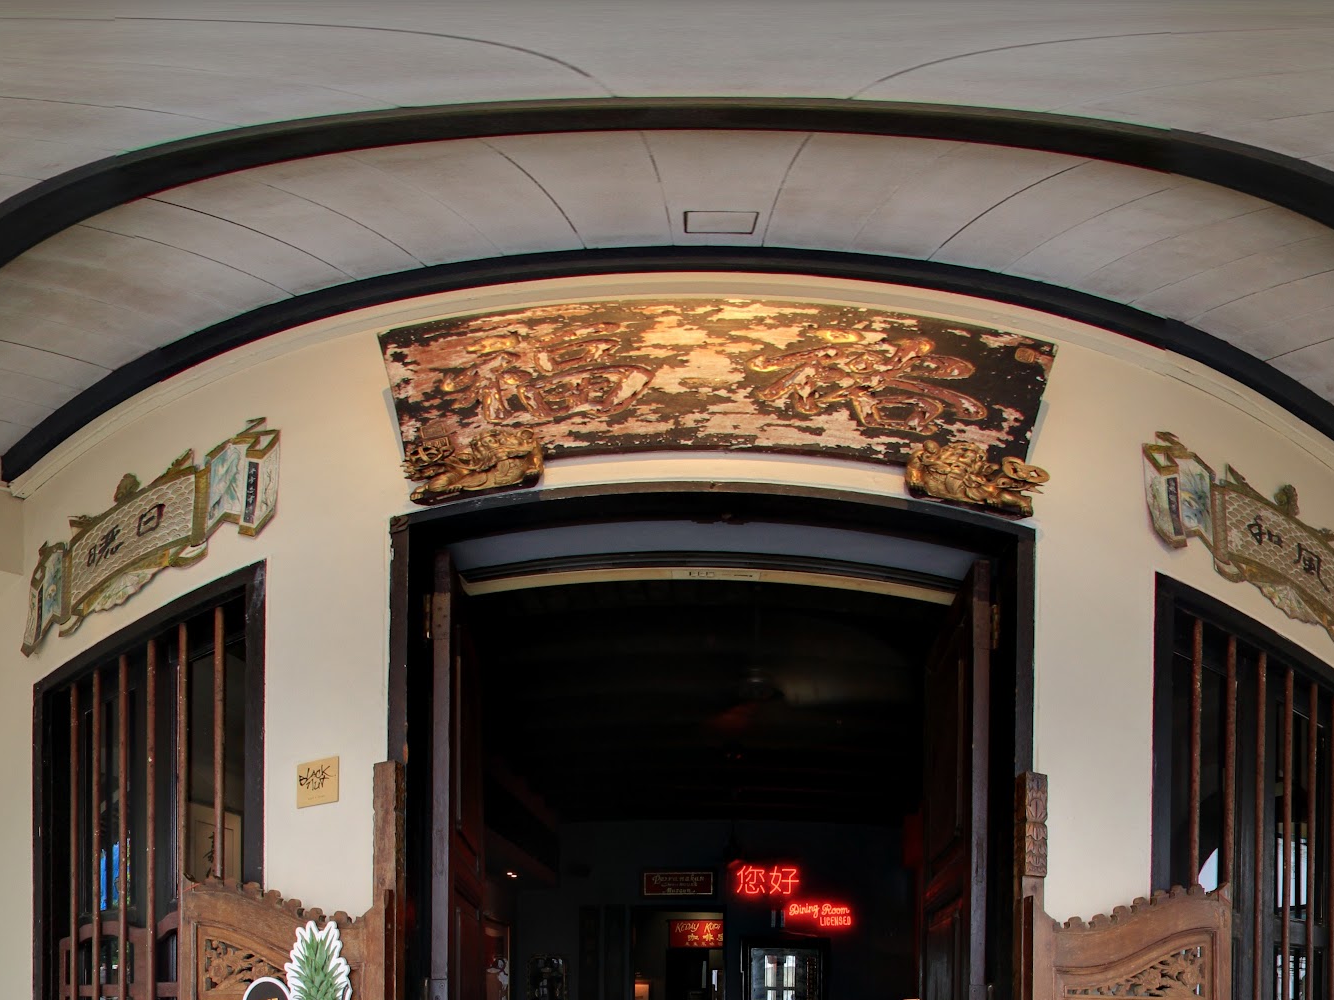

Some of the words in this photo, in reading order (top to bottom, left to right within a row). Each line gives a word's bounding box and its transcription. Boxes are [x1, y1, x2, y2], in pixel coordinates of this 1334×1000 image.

[736, 866, 799, 894] 您好
[789, 903, 819, 918] Dining
[821, 904, 849, 915] Room
[820, 917, 851, 926] LICENSED
